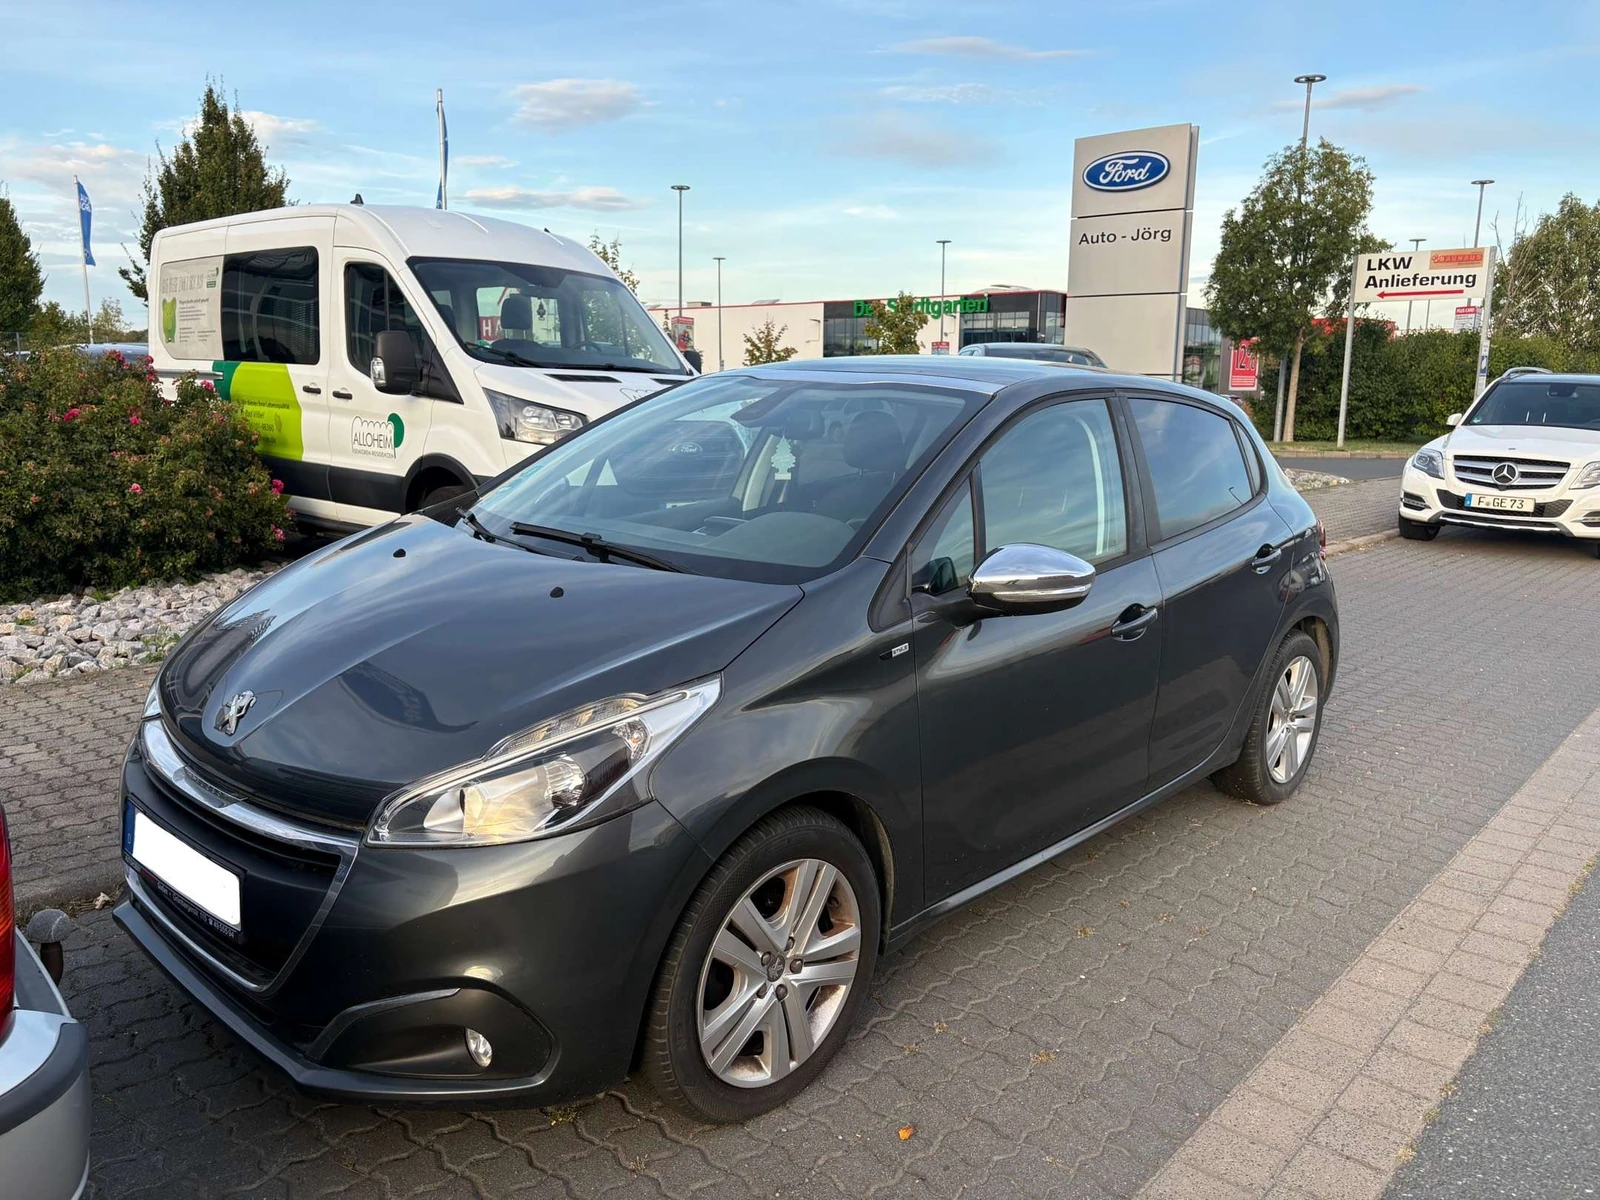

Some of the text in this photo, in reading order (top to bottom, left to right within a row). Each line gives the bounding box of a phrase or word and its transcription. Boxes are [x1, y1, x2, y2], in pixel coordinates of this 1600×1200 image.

[1099, 158, 1152, 184] Ford
[1078, 231, 1117, 246] Auto
[1130, 226, 1172, 243] Jörg
[1366, 256, 1413, 272] LKW
[1439, 253, 1482, 263] BAUHAUS
[1363, 272, 1477, 289] Anlieferung
[353, 431, 394, 450] ALLOHEIM
[1477, 496, 1525, 510] F GE 73
